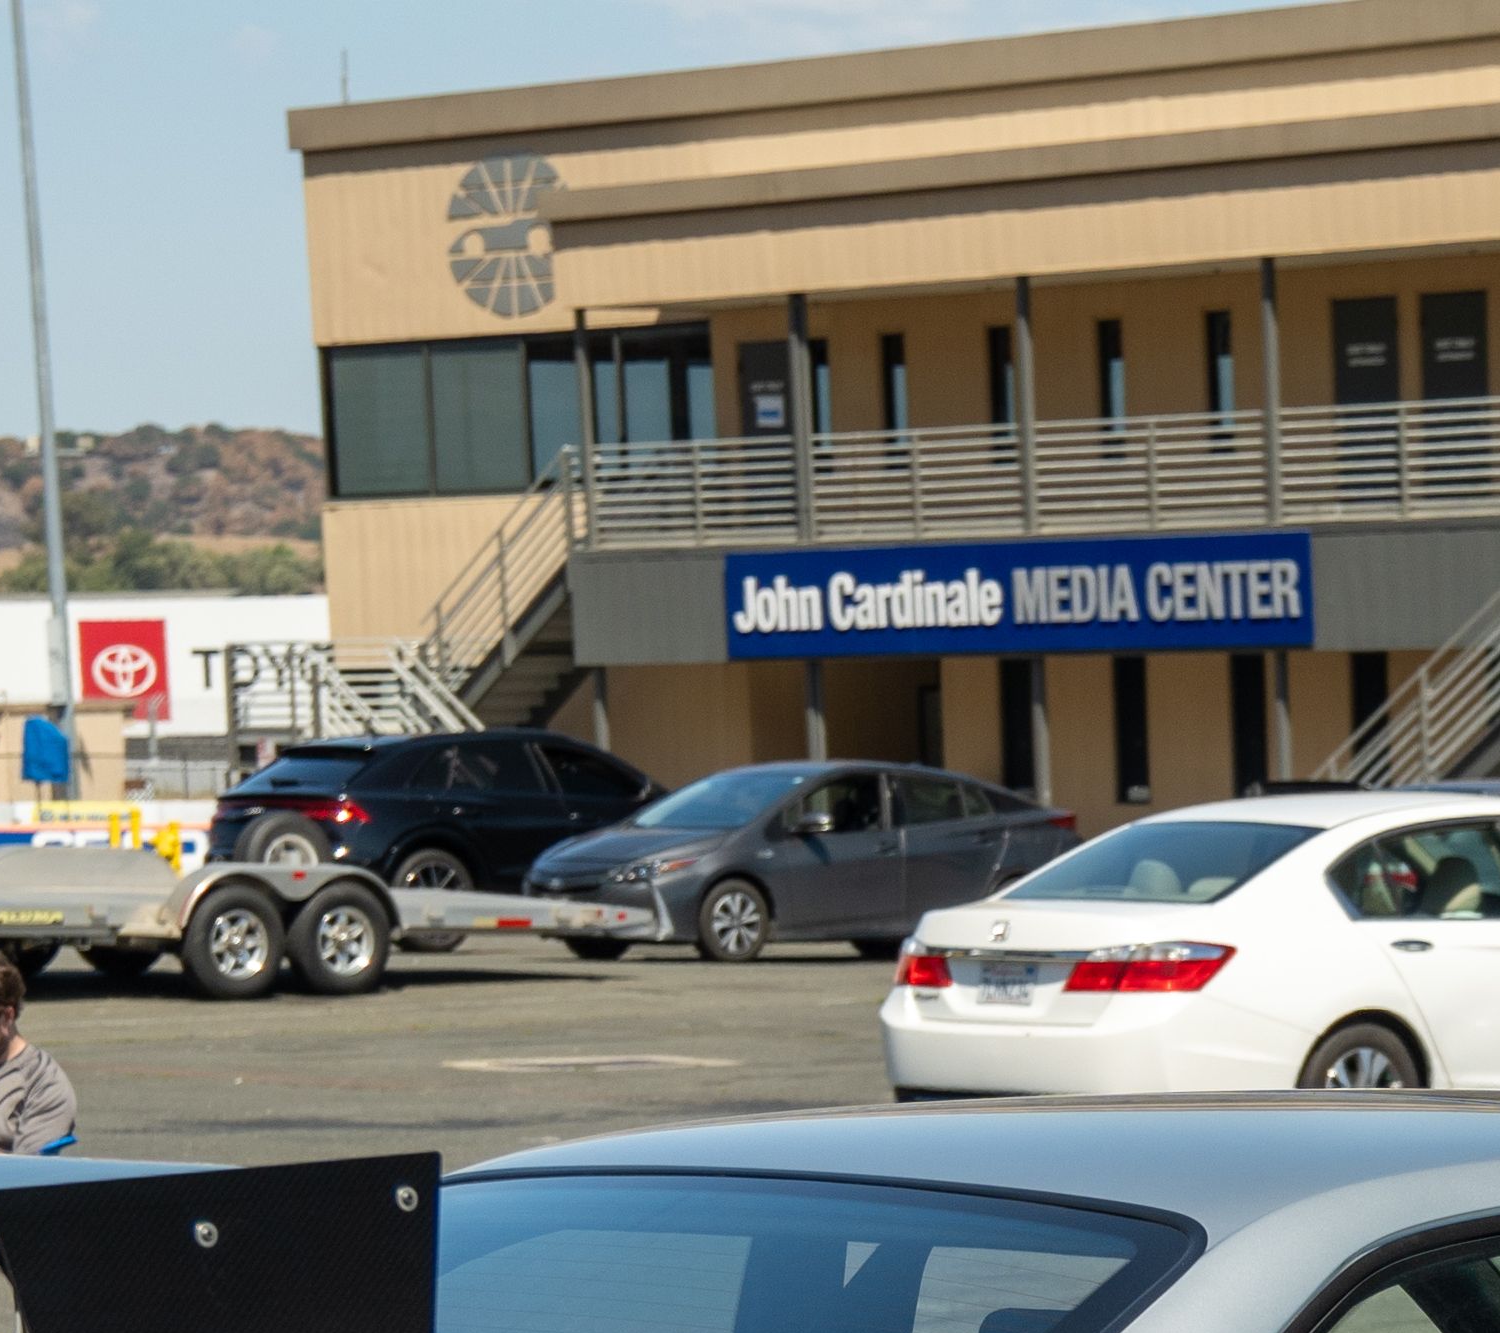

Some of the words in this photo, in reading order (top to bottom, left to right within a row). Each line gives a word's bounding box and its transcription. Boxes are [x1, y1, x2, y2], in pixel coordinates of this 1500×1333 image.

[733, 576, 822, 634] John
[828, 568, 1003, 632] Cardinale
[1012, 565, 1139, 625] MEDIA
[1146, 559, 1301, 622] CENTER
